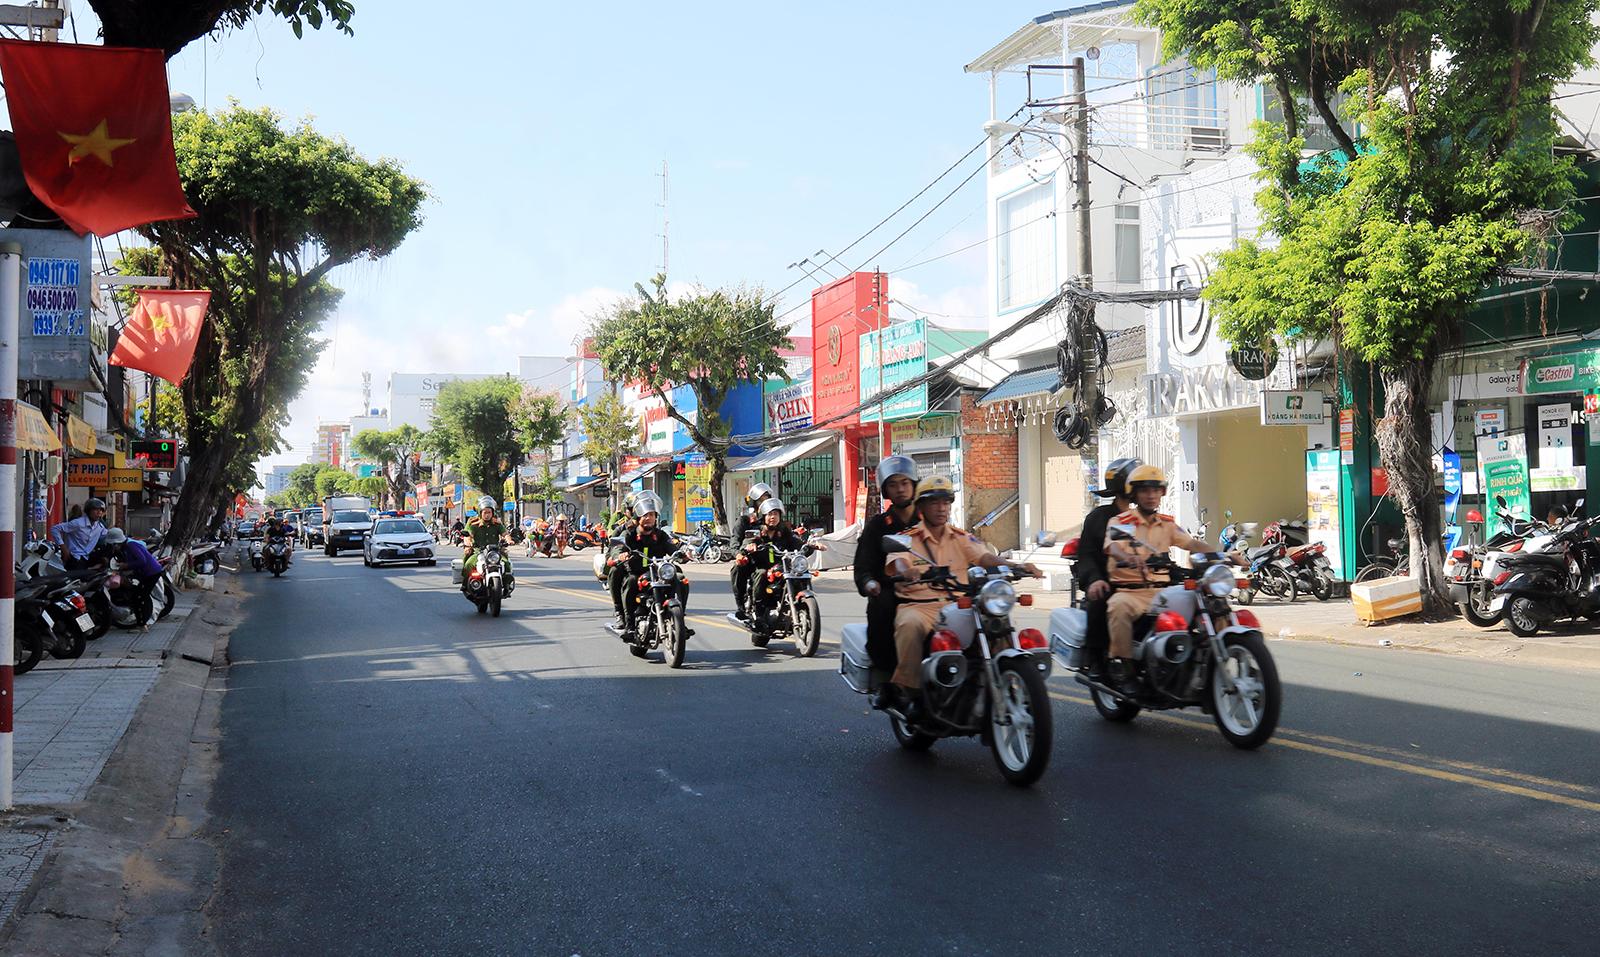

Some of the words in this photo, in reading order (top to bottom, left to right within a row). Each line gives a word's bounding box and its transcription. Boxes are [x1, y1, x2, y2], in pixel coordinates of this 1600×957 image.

[28, 261, 80, 286] 0949.117.161
[27, 289, 77, 312] 0946.500.300
[1544, 366, 1573, 381] Castrol
[112, 476, 138, 484] STORE
